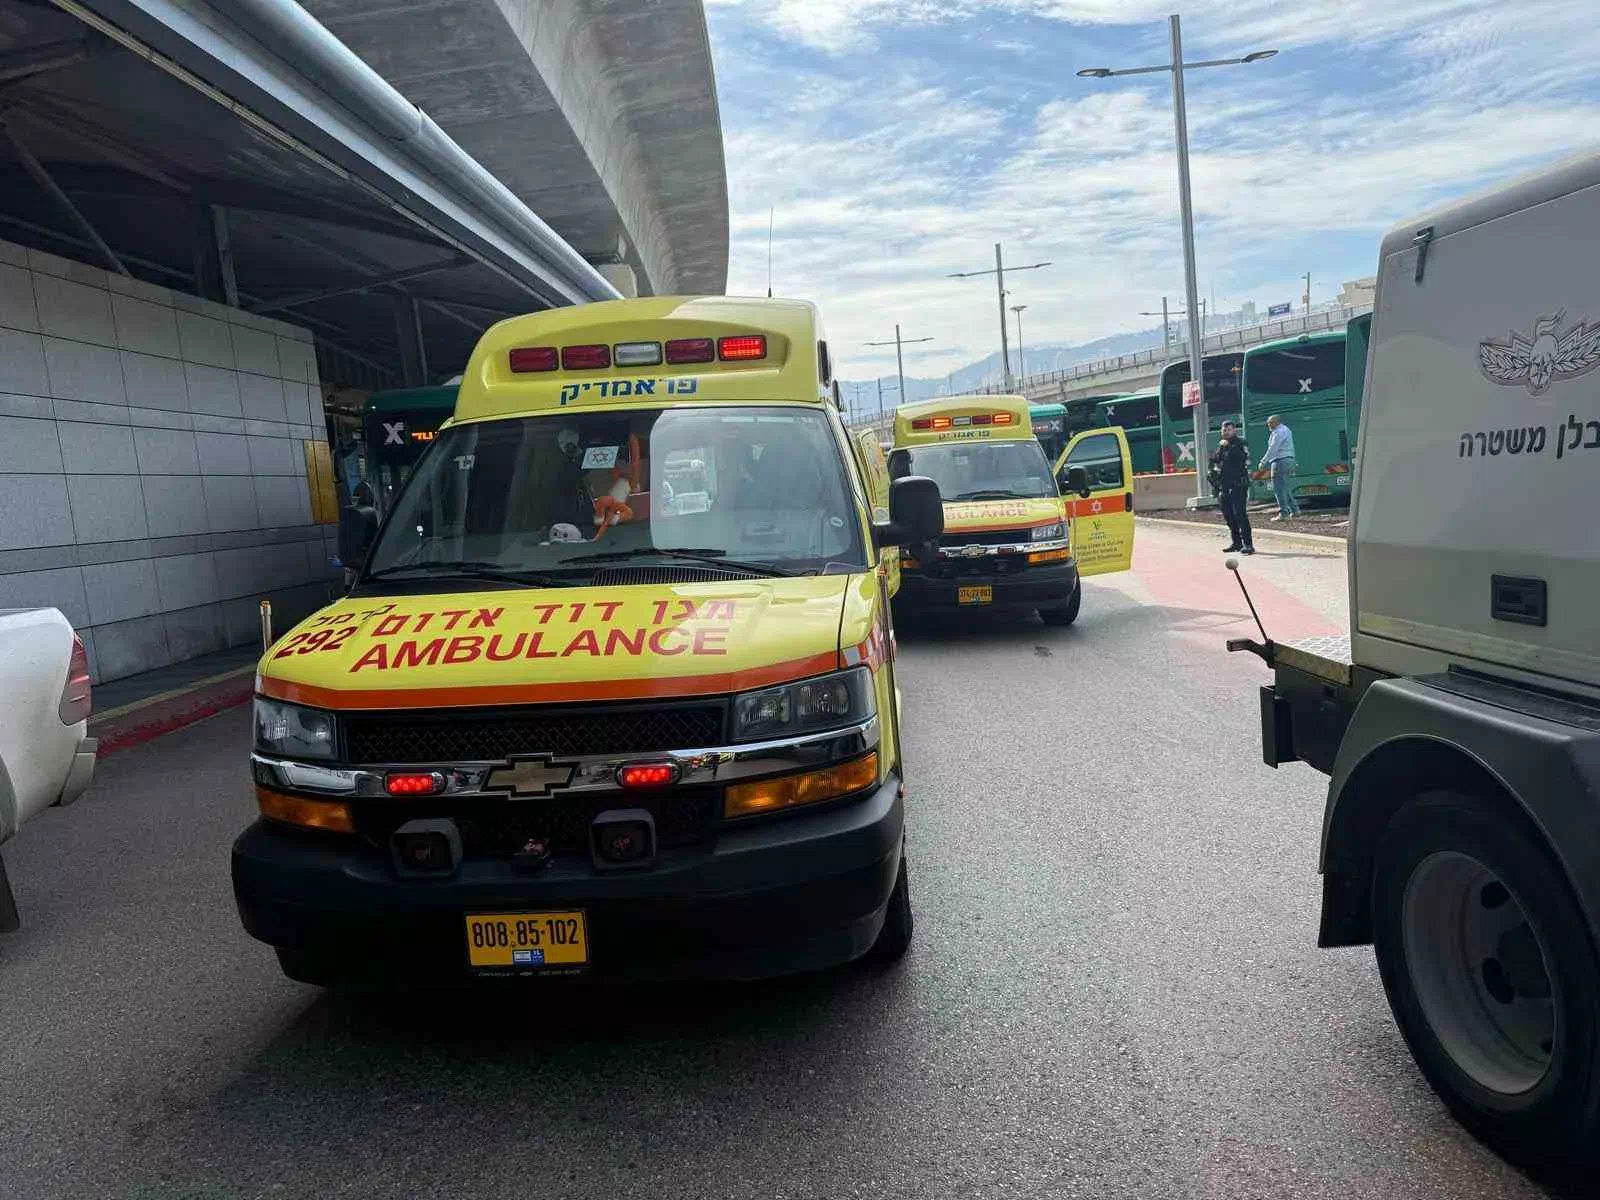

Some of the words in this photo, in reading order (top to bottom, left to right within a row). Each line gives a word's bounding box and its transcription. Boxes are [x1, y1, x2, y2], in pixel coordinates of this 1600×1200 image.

[1459, 425, 1547, 458] משטרה
[944, 507, 1028, 520] BULANCE
[371, 607, 506, 637] אדום
[533, 601, 625, 625] דוד
[651, 600, 735, 625] מגן
[273, 625, 359, 660] 292
[349, 627, 730, 673] AMBULANCE
